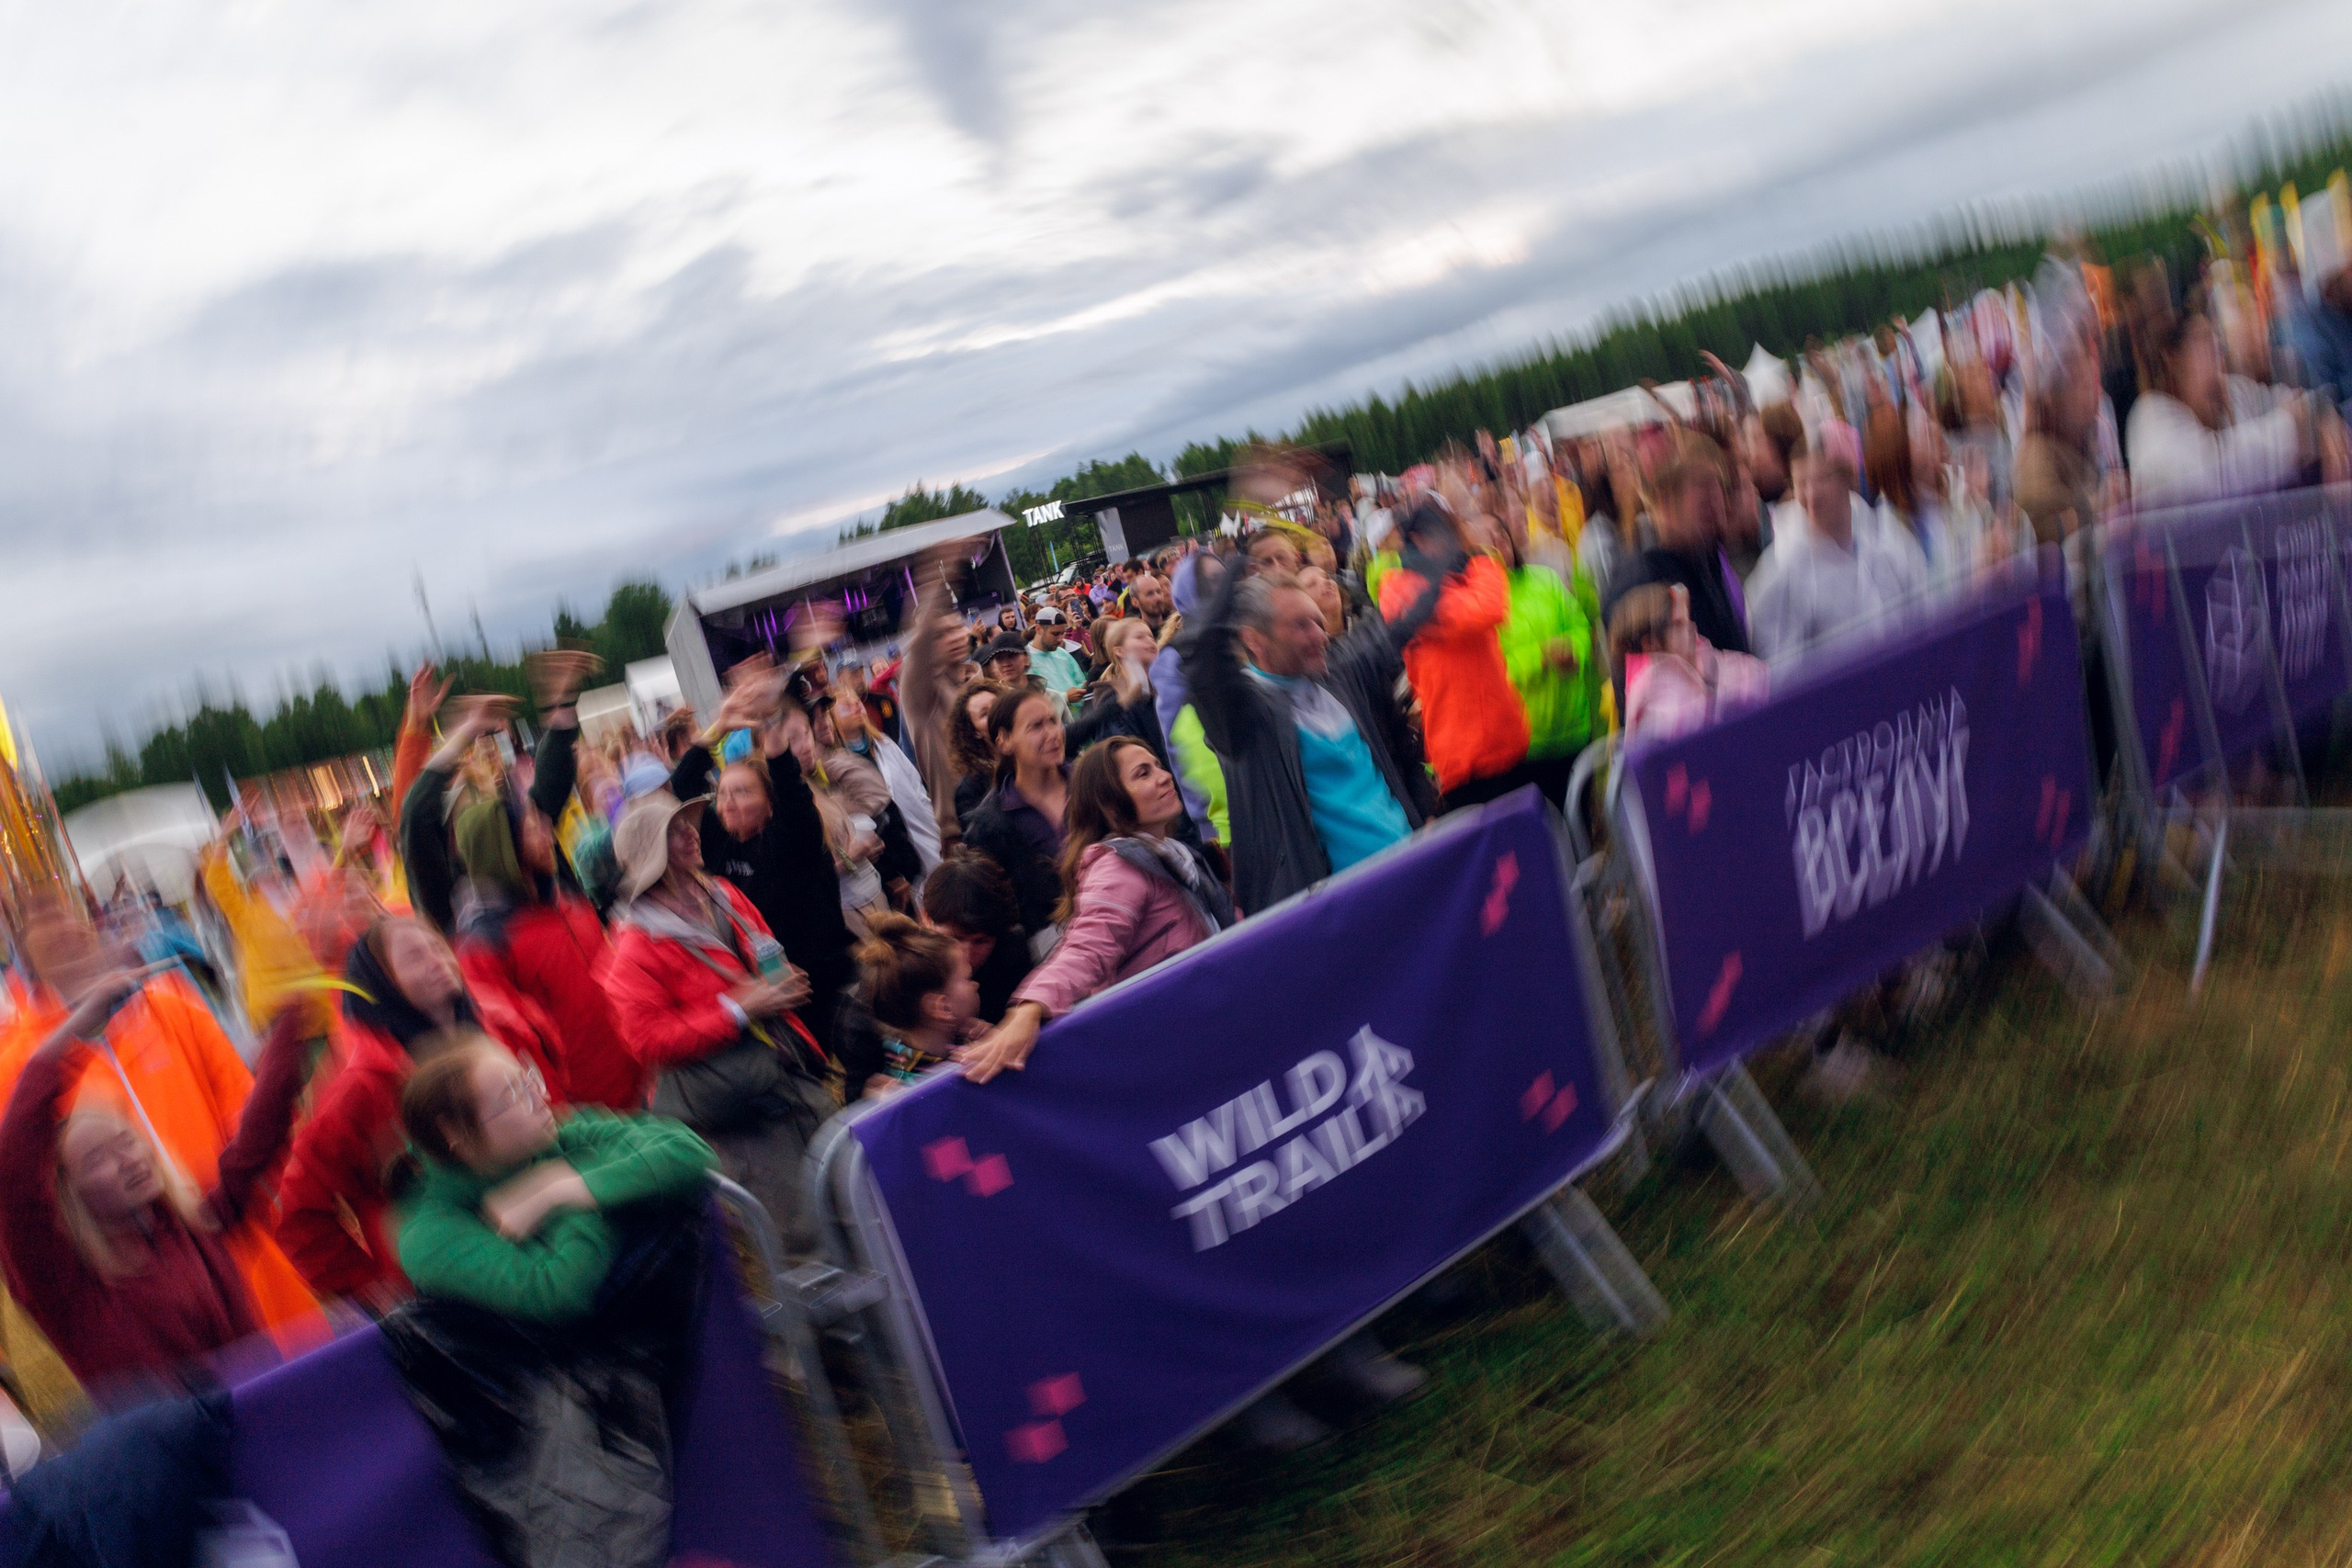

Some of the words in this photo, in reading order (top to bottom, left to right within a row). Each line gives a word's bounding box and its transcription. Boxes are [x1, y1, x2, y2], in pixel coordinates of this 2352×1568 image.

[1022, 500, 1065, 527] TANK
[1147, 1048, 1347, 1191] WILD
[1170, 1104, 1389, 1253] TRAIL
